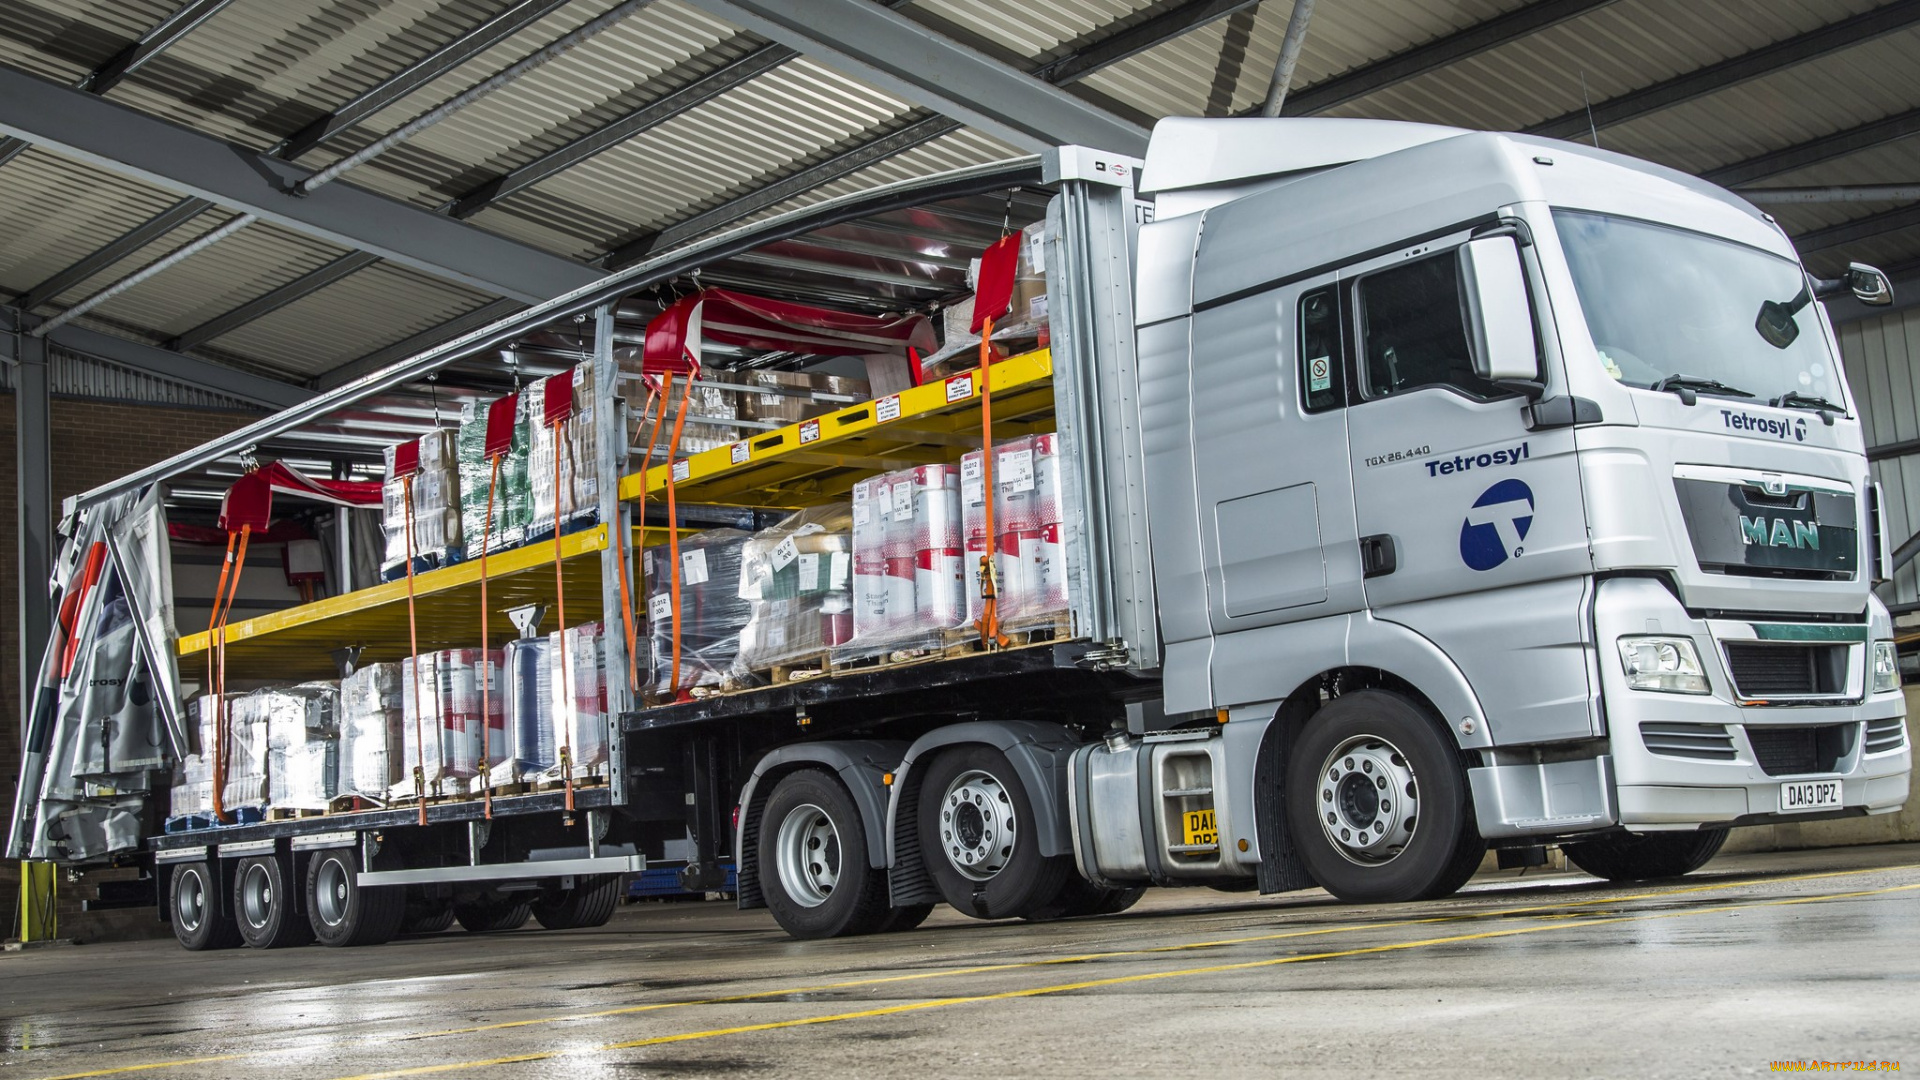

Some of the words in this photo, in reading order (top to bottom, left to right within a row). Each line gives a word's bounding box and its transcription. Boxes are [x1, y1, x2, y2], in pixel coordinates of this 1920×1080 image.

[1135, 204, 1155, 224] TE
[1720, 409, 1791, 439] Tetrosyl
[1364, 454, 1387, 467] TGX
[1387, 445, 1432, 462] 26.440
[1425, 441, 1530, 477] Tetrosyl
[1739, 515, 1819, 550] MAN
[1788, 784, 1814, 805] DA13
[1816, 783, 1837, 804] DPZ
[1190, 812, 1217, 832] DA1
